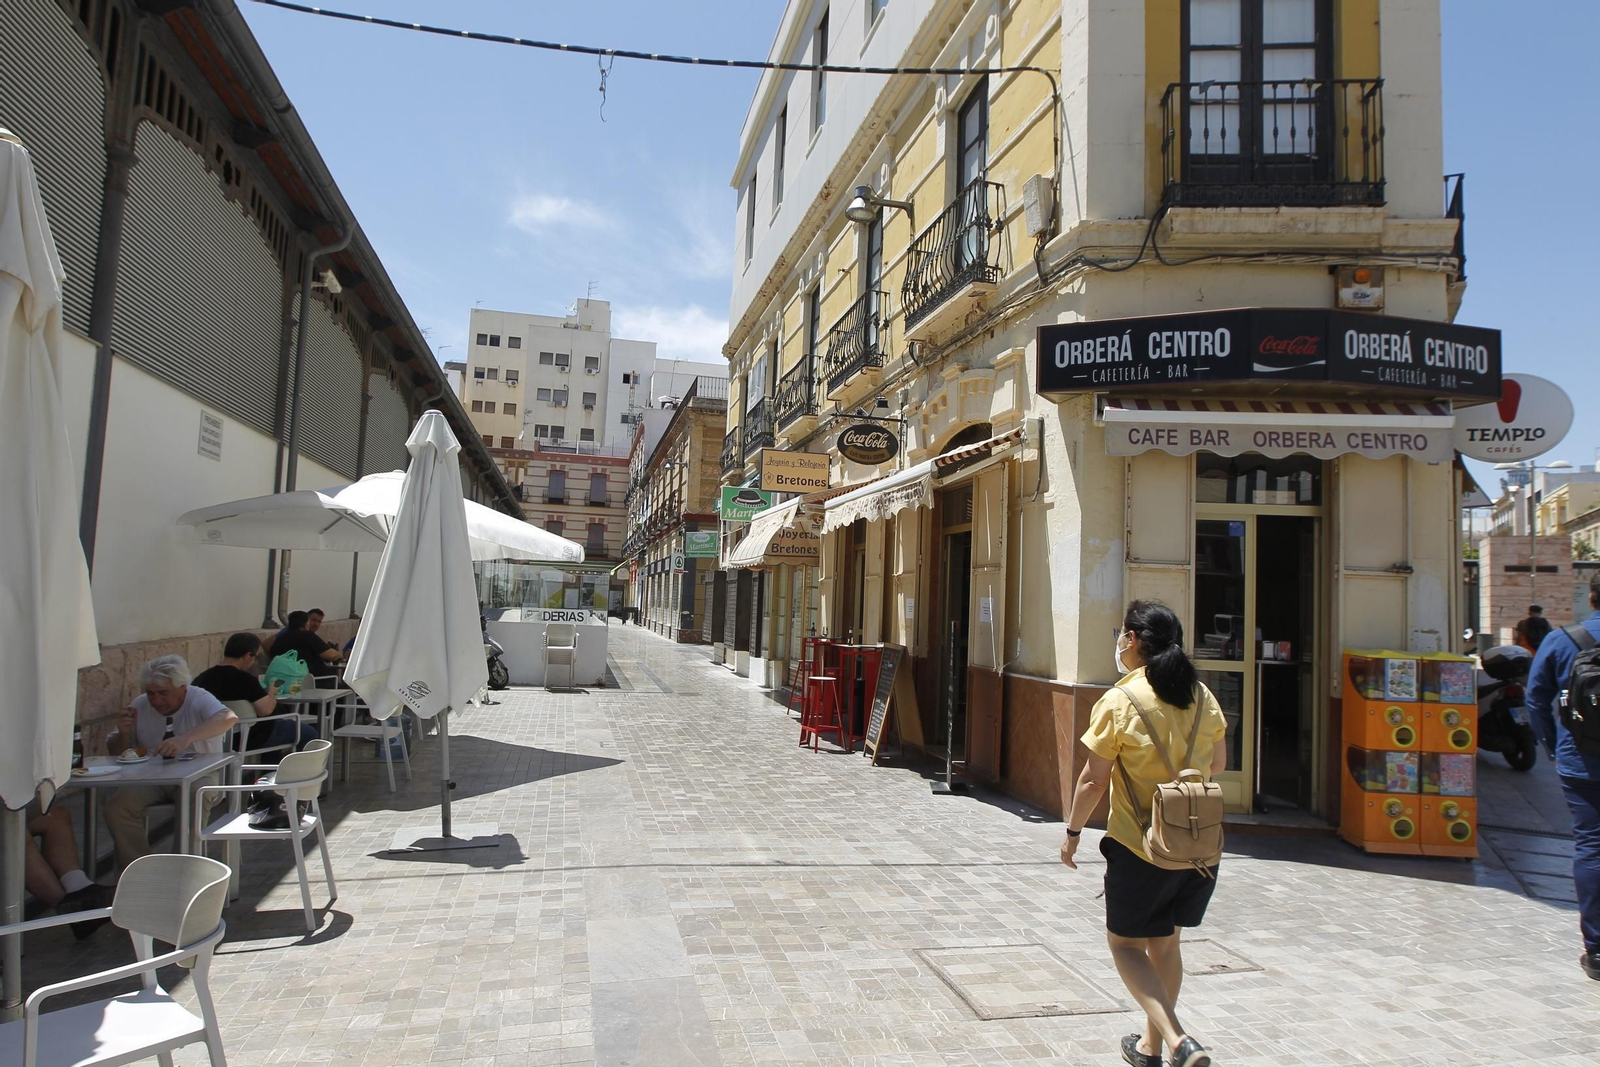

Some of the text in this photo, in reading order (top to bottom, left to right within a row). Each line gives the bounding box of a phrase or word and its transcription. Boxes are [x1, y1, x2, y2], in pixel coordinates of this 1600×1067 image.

[1054, 327, 1231, 368] ORBERÁ CENTRO
[1259, 335, 1322, 355] Coca-Cola
[1344, 329, 1488, 374] ORBERÁ CENTRO
[1092, 363, 1189, 383] CAFETERÍA BAR
[1378, 366, 1458, 388] CAFETERÍA BAR
[843, 430, 890, 449] Coca-Cola
[1128, 428, 1428, 451] CAFE BAR ORBERA CENTRO
[1466, 427, 1546, 442] TEMPLO
[1486, 444, 1522, 453] CAFÉS
[776, 474, 827, 487] Bretones
[771, 543, 818, 554] Bretones
